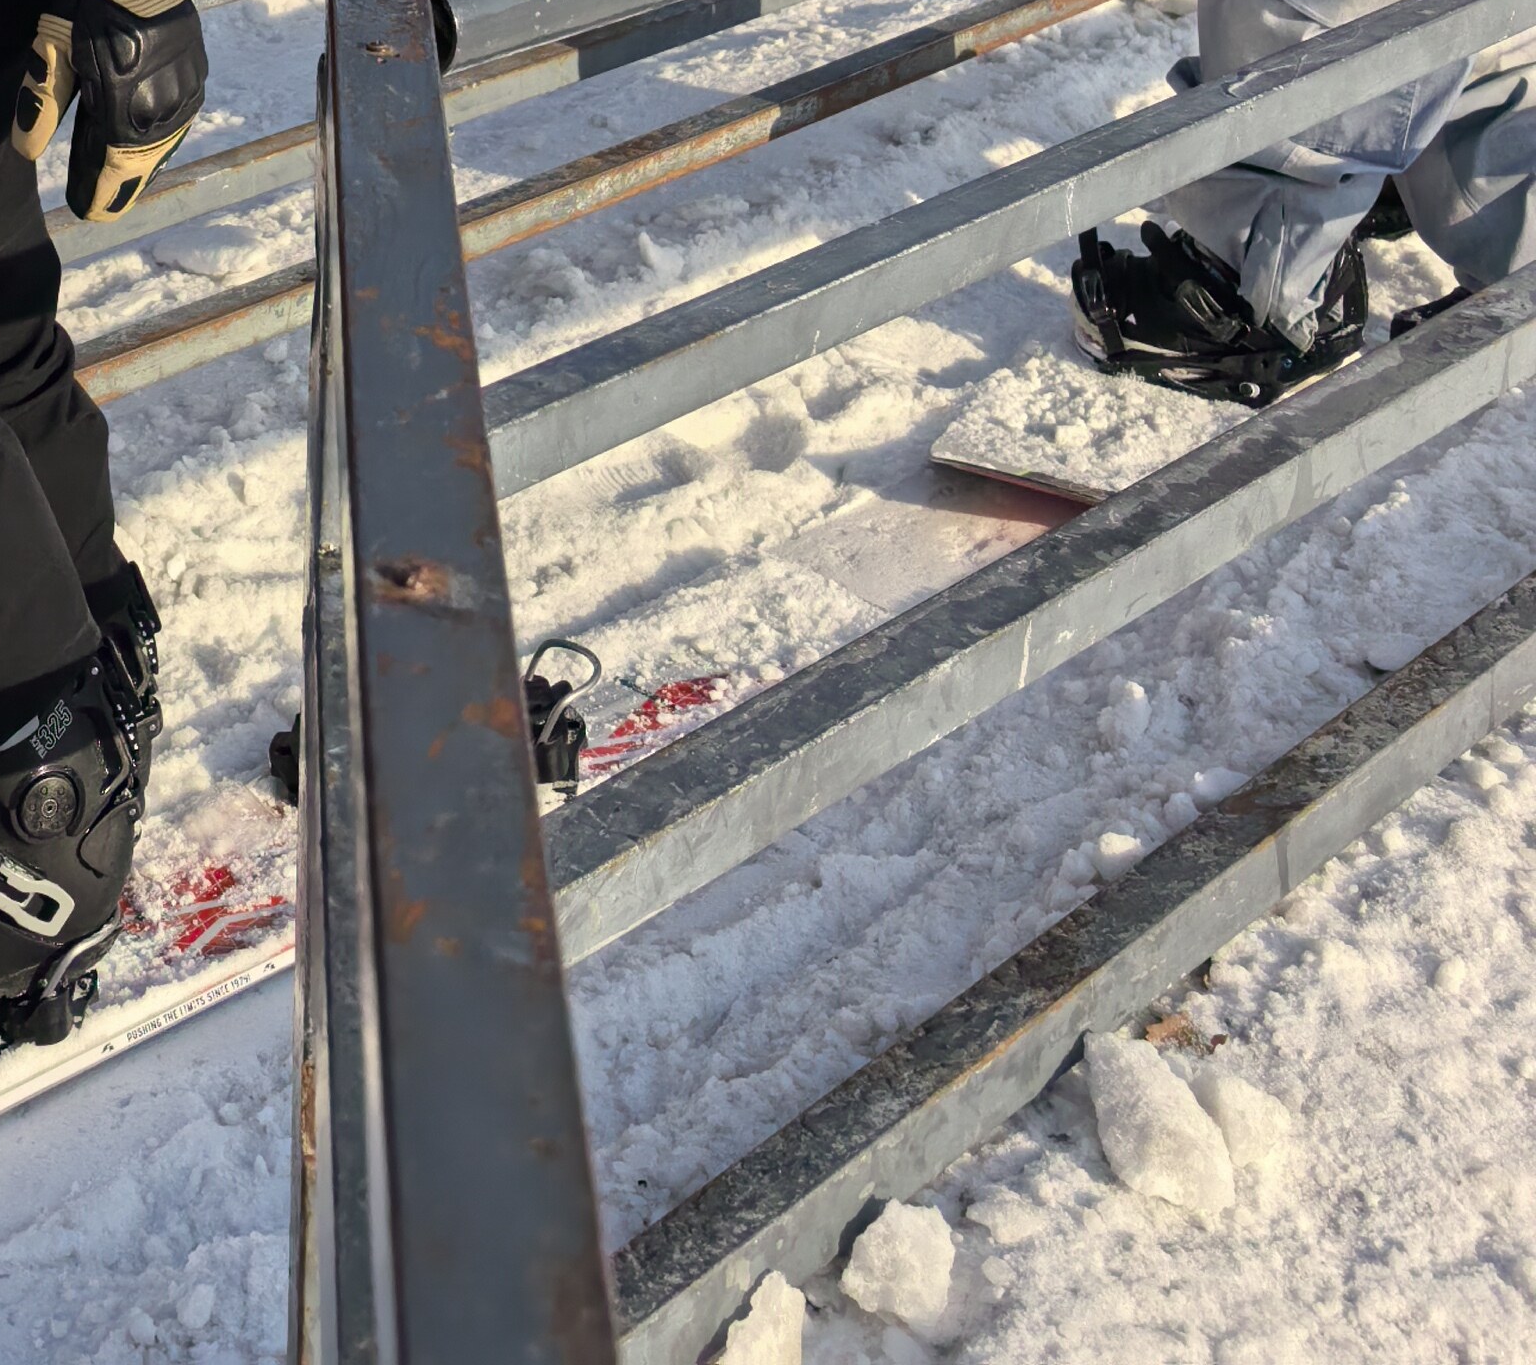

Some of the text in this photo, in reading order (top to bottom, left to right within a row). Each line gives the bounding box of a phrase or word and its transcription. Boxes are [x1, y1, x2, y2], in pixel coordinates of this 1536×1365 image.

[37, 699, 73, 750] 325
[126, 1017, 163, 1042] PUSHING
[163, 1009, 179, 1025] THE
